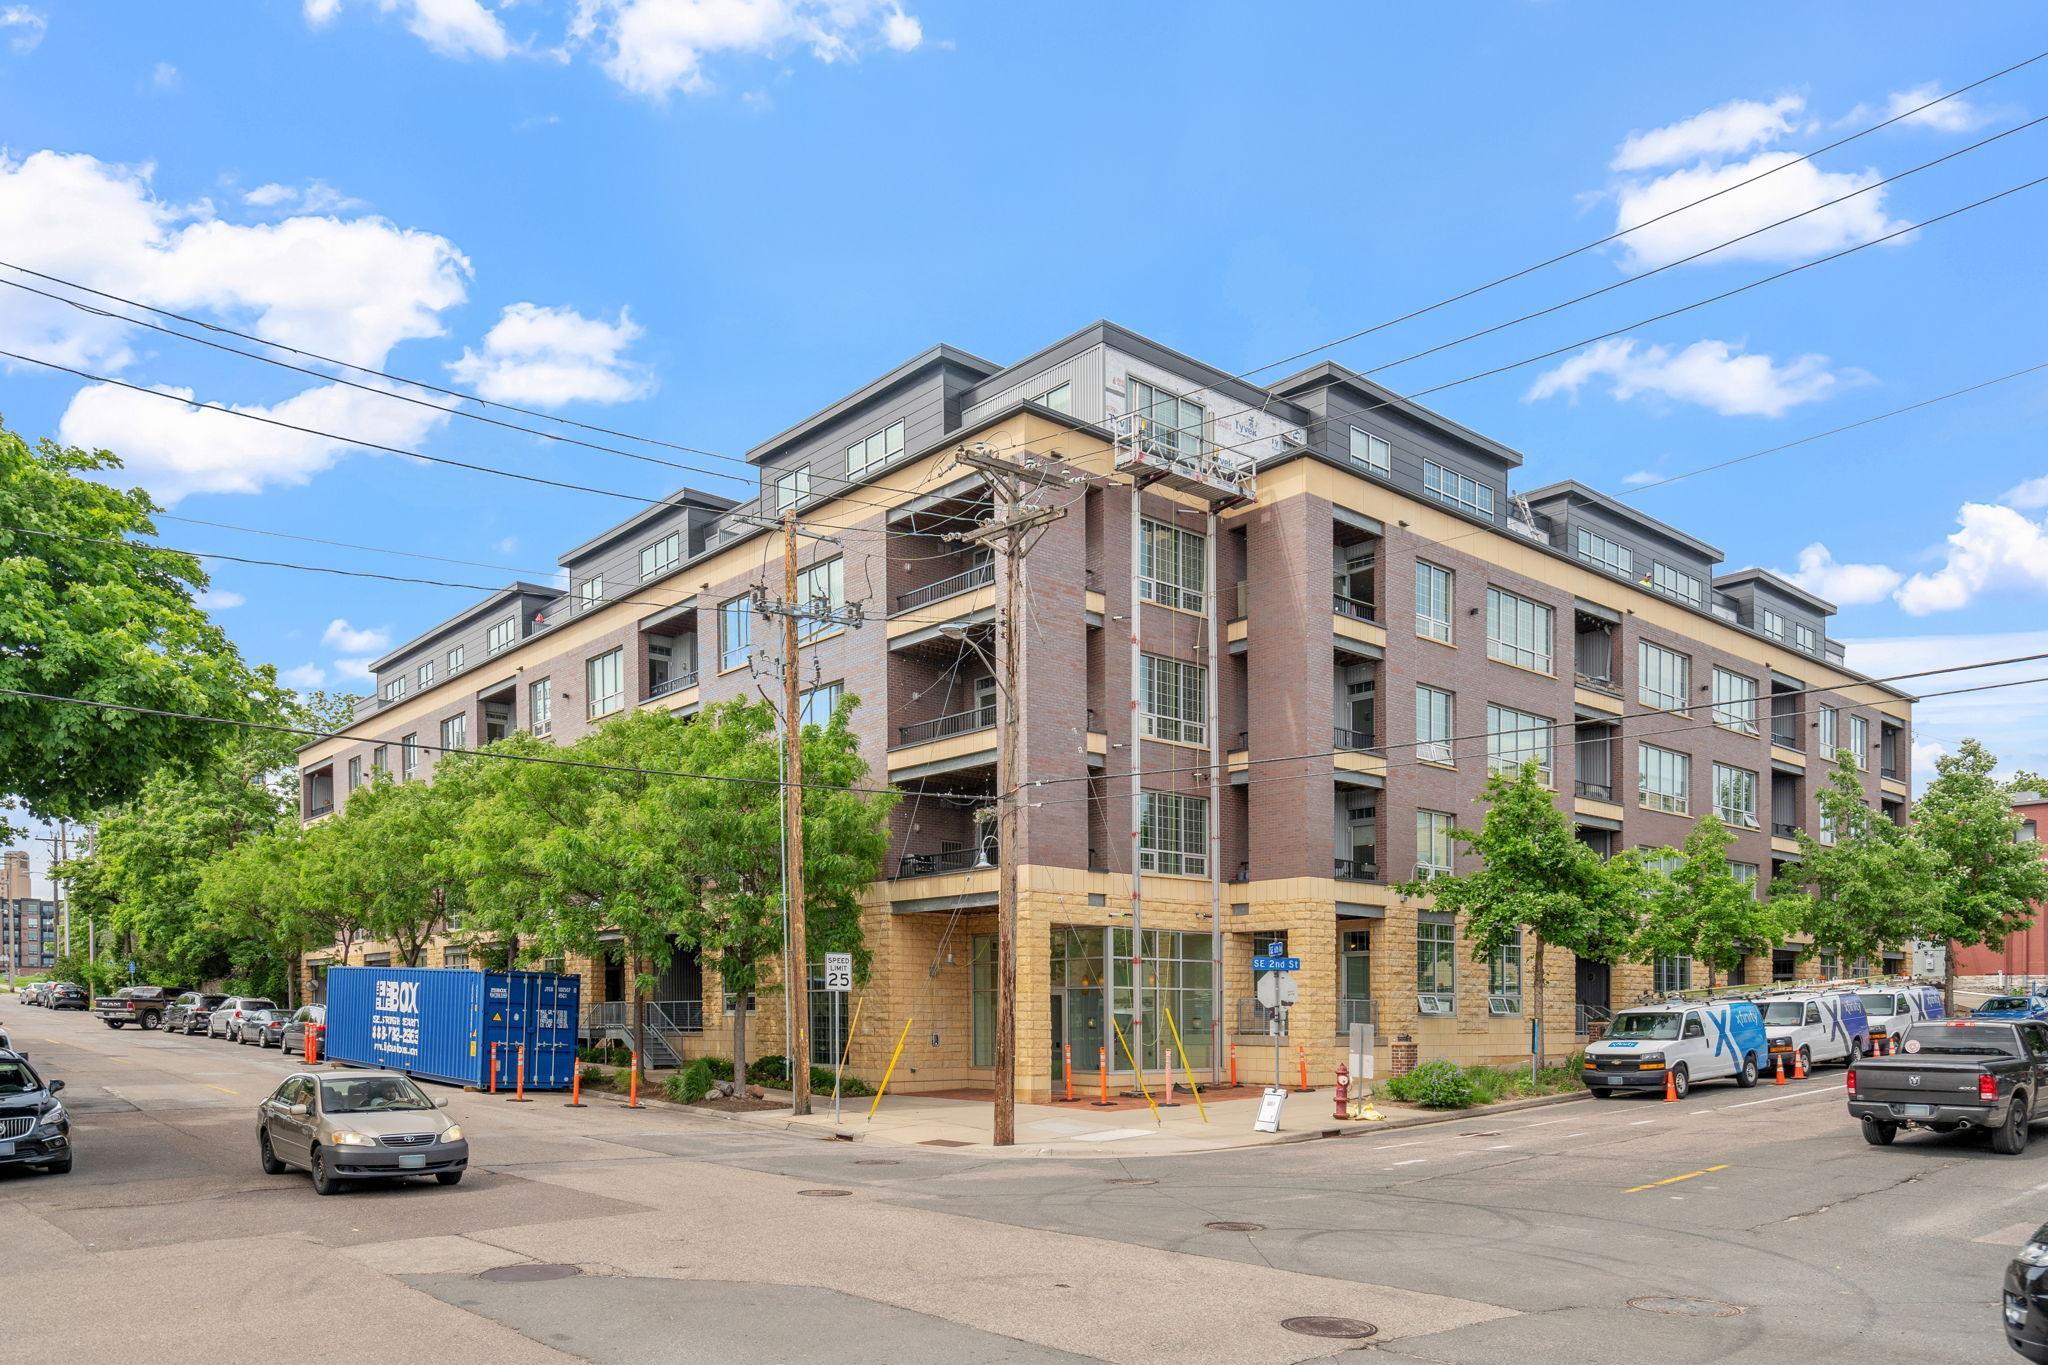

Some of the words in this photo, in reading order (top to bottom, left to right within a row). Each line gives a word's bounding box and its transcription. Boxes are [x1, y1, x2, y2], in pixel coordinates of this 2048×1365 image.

[1235, 419, 1257, 437] Tyvek
[1254, 959, 1265, 968] SE
[1269, 960, 1285, 968] 2nd
[1288, 960, 1299, 968] St
[828, 972, 849, 987] 25
[1736, 1010, 1758, 1028] xfinity
